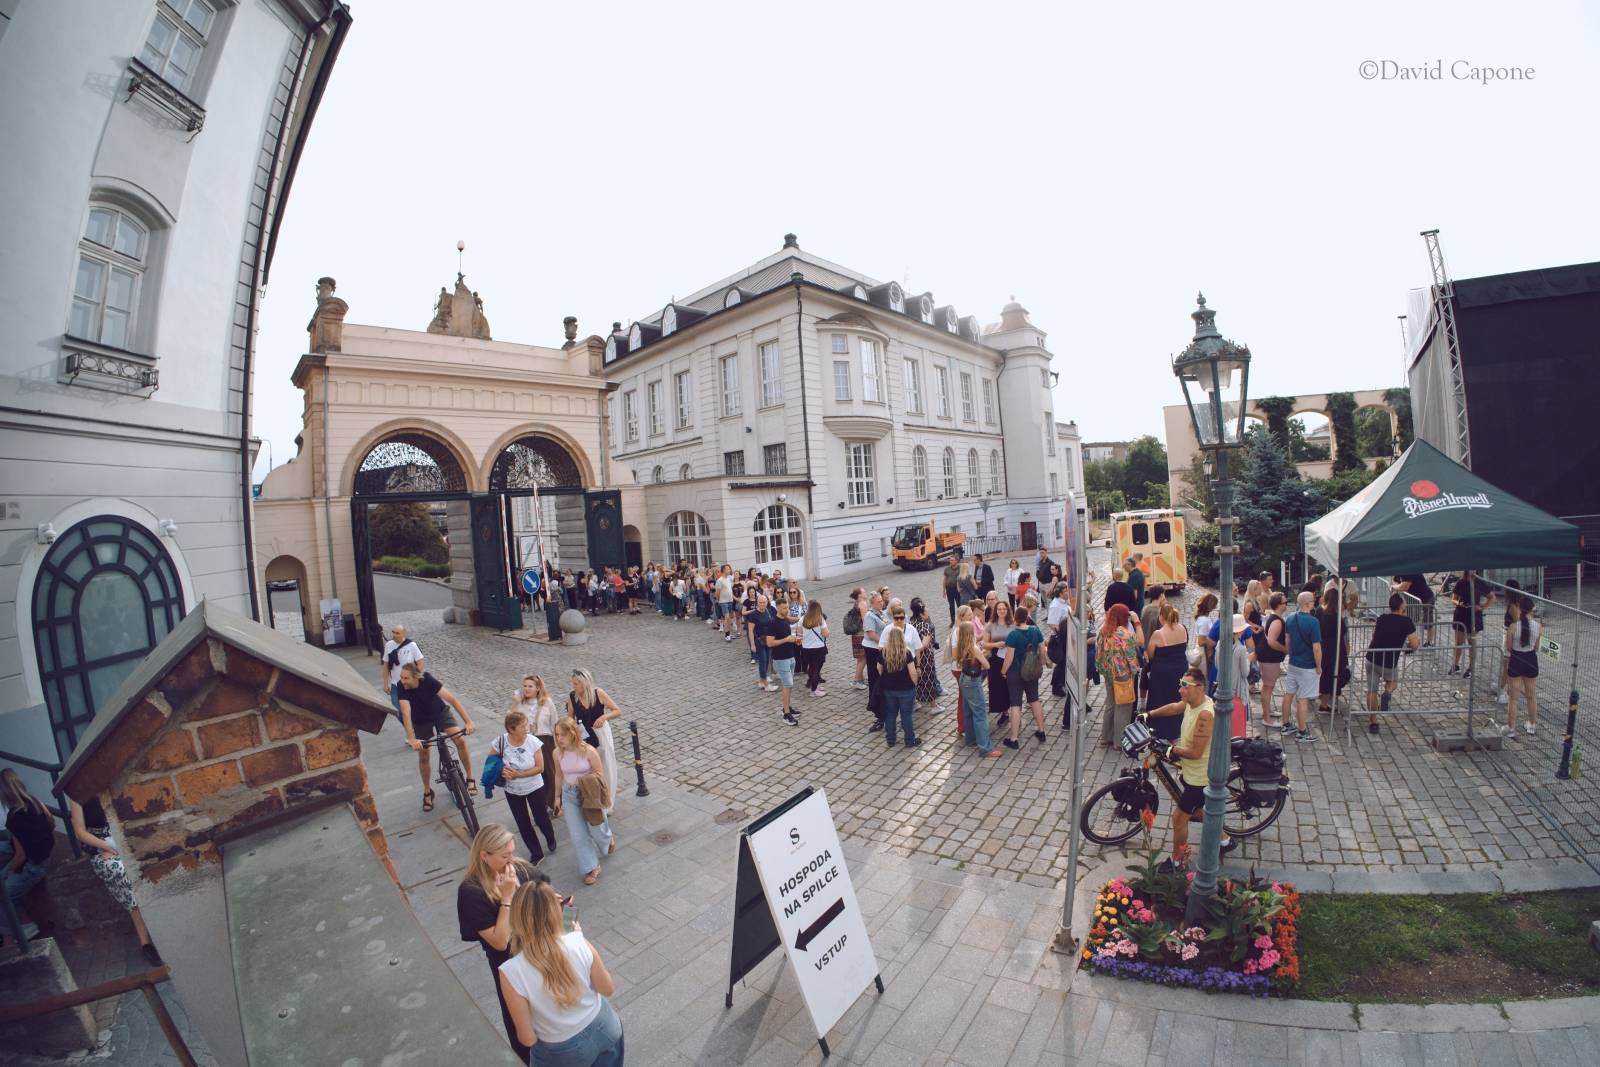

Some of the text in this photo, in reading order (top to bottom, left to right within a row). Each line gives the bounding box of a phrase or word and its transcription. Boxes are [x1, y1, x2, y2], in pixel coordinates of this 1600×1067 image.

[1402, 492, 1490, 518] Pilsner Urquell
[779, 849, 832, 898] HOSPODA
[784, 865, 839, 919] NA SPILCE
[814, 934, 848, 971] VSTUP
